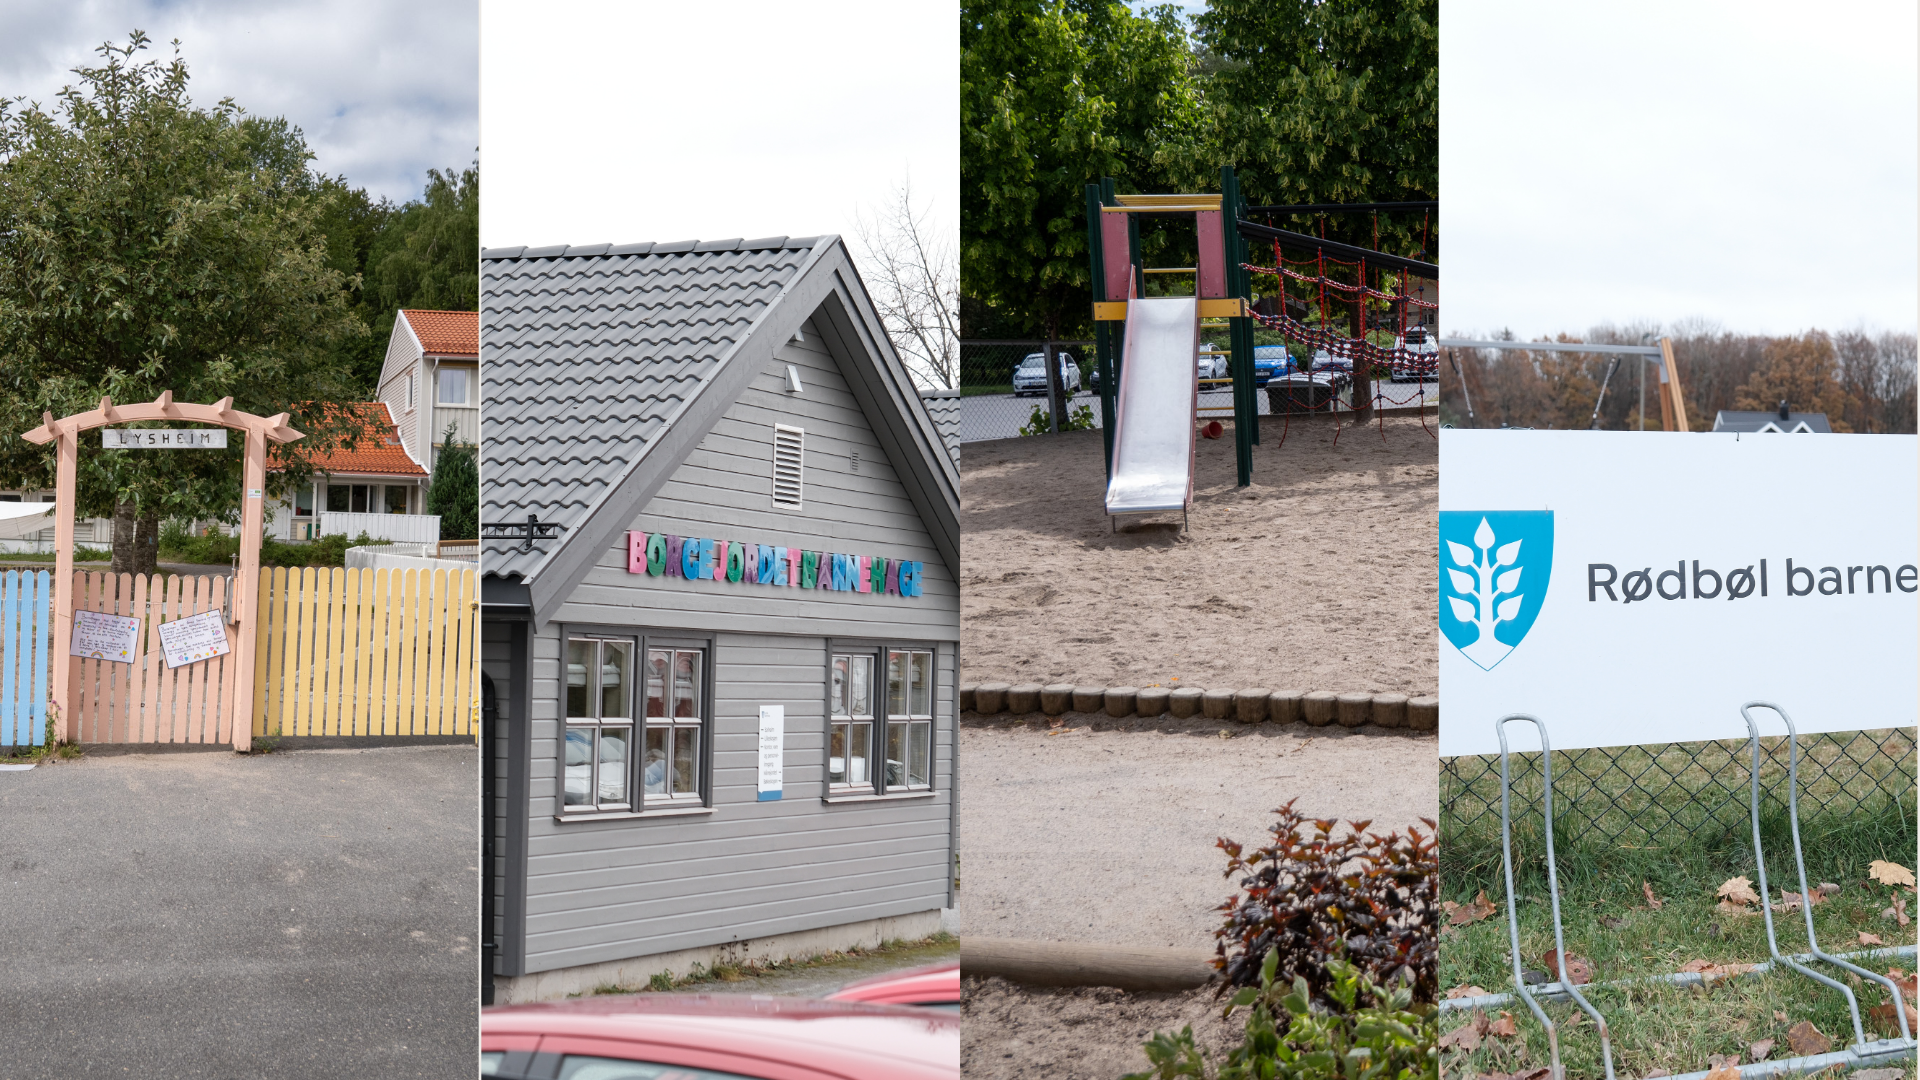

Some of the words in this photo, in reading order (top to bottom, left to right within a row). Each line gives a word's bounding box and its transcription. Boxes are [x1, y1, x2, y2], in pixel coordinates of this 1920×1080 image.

[120, 433, 210, 444] LYSHEIM
[1587, 558, 1768, 604] Rødbøl
[1786, 557, 1918, 596] barne
